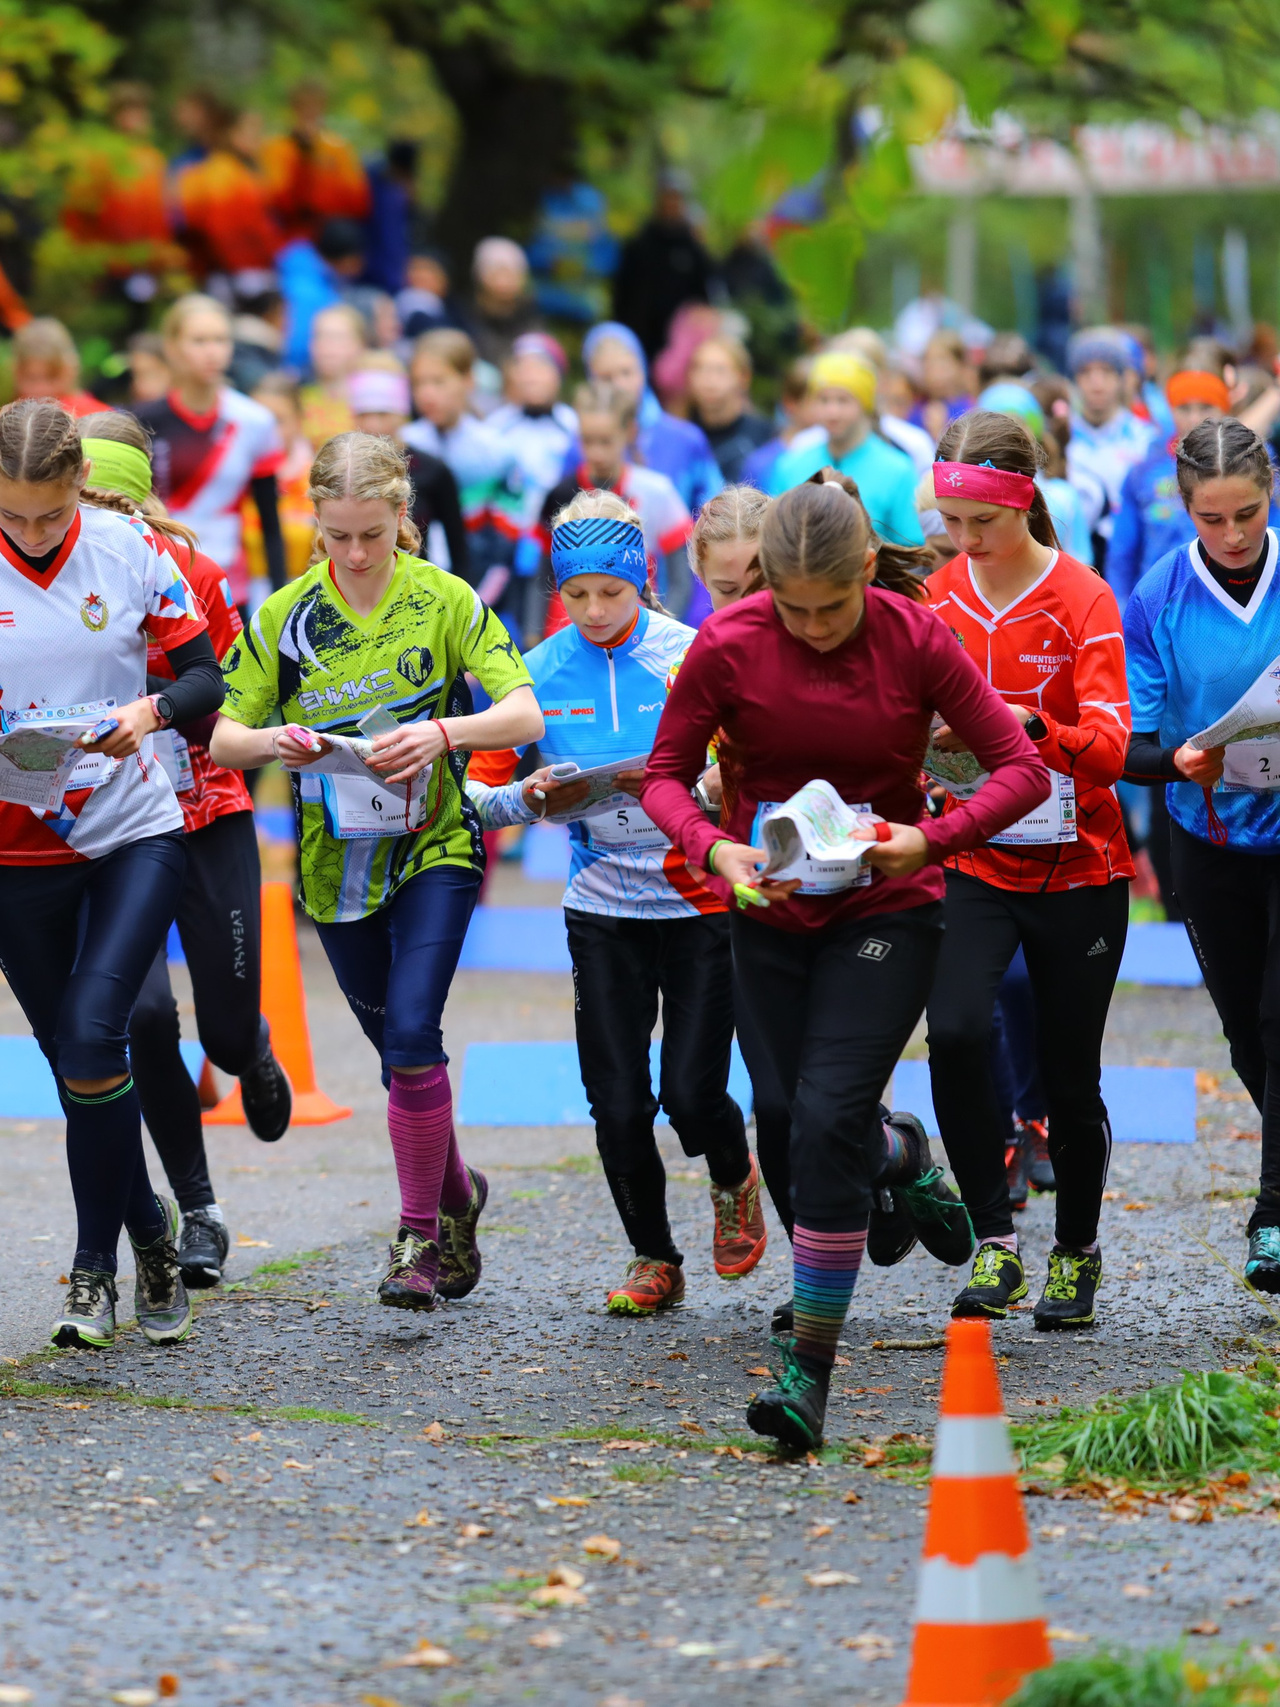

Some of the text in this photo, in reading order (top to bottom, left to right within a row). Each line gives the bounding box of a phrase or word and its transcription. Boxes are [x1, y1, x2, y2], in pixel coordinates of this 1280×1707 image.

[1036, 664, 1061, 673] TEAM
[1258, 757, 1271, 773] 2
[371, 795, 383, 812] 6
[616, 810, 629, 826] 5
